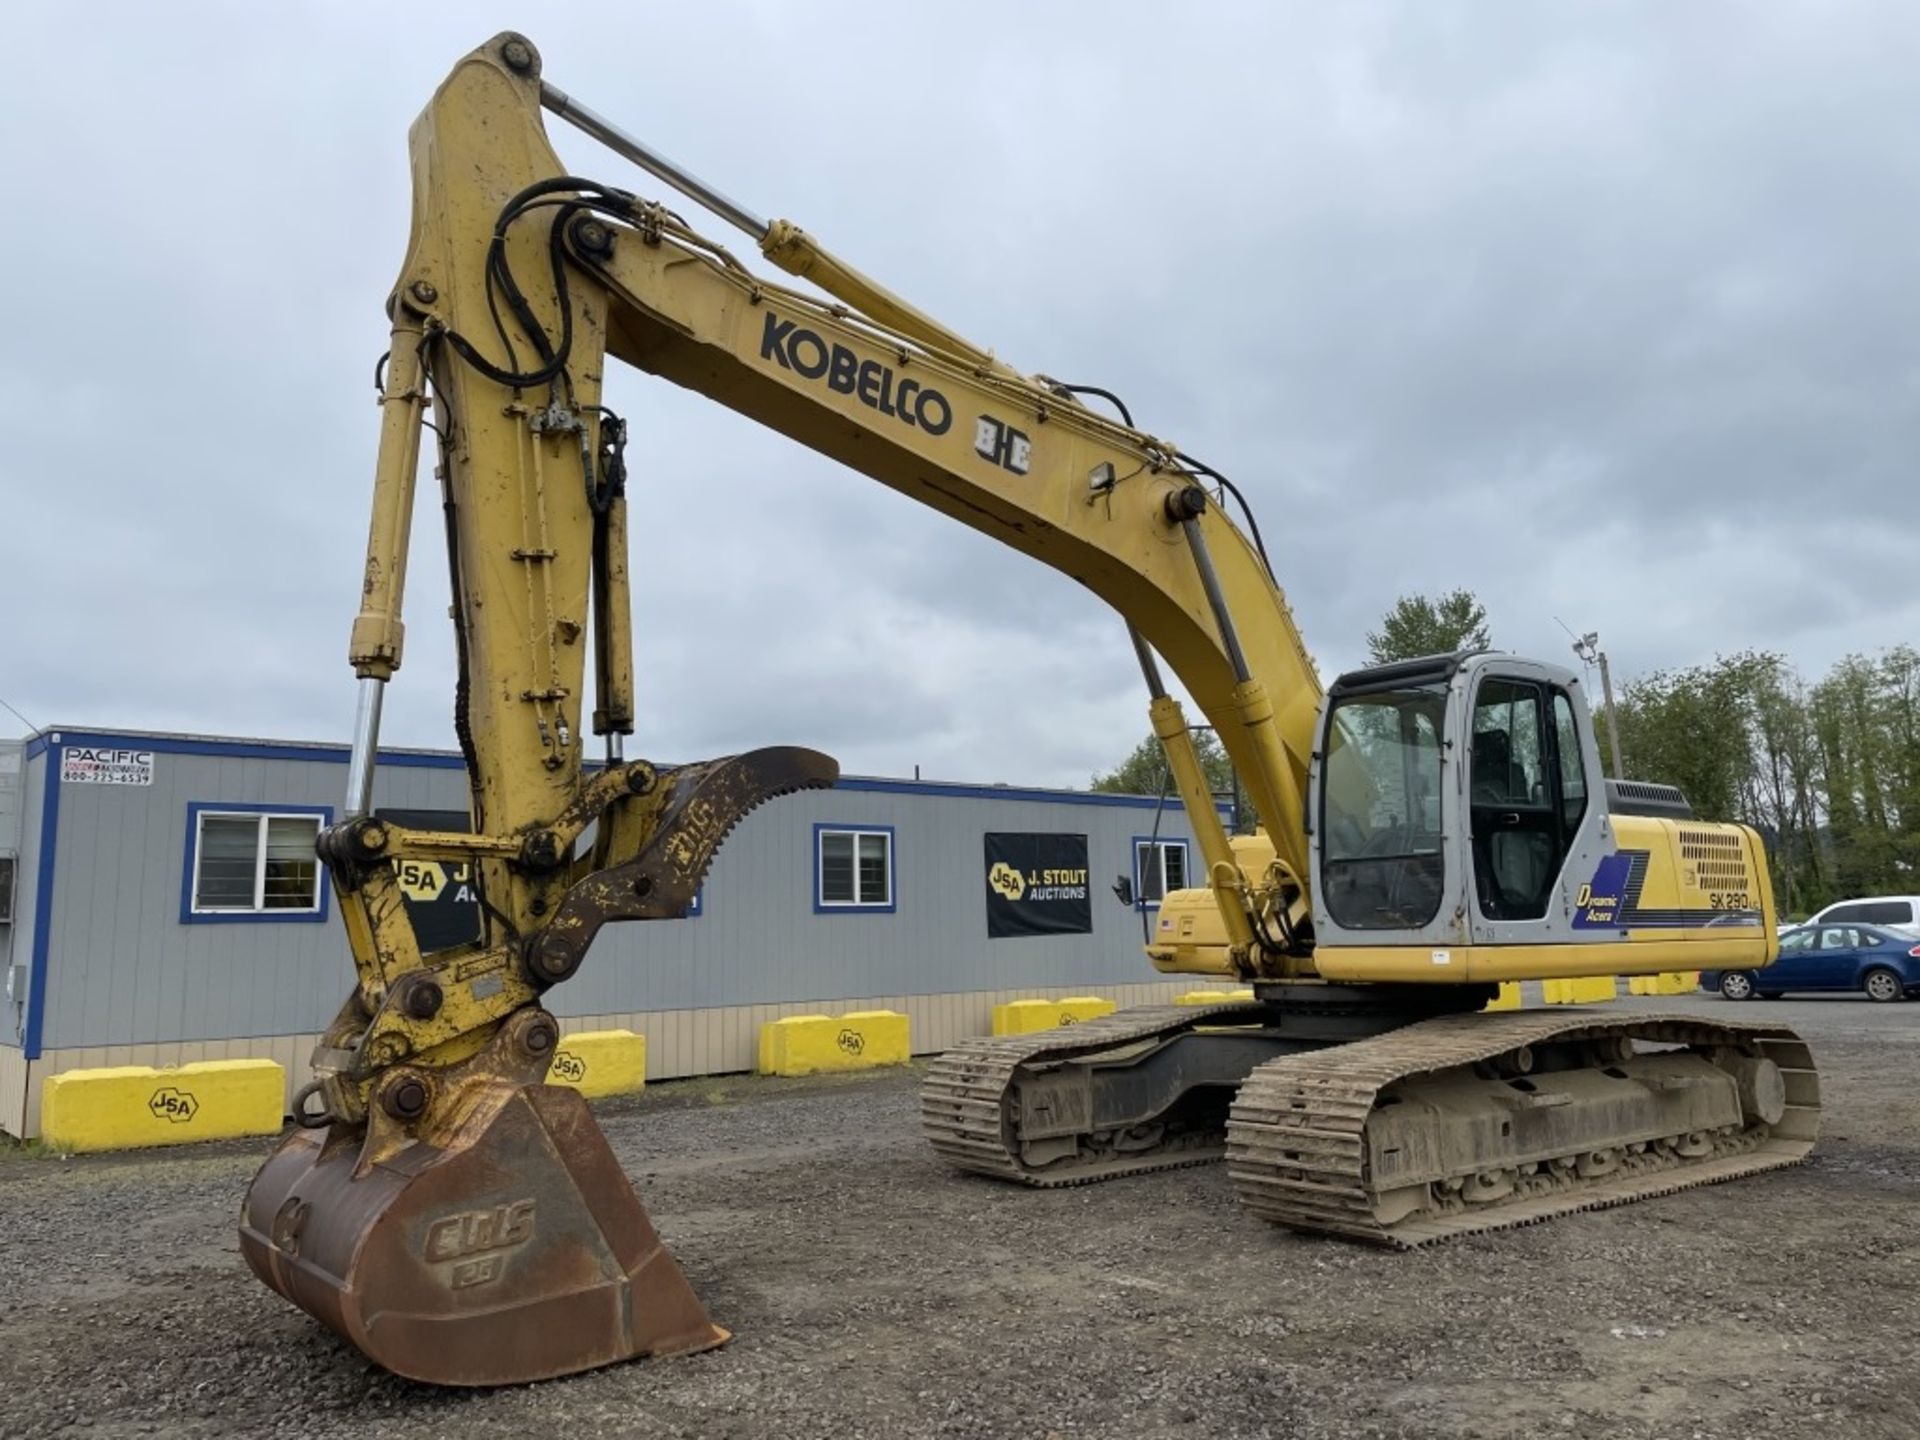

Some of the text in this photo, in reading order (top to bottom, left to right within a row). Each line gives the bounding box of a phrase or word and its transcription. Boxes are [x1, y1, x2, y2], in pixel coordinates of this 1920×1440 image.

[760, 311, 953, 436] KOBELCO
[992, 868, 1020, 893] JSA
[1028, 869, 1087, 886] J. STOUT
[1029, 886, 1086, 901] AUCTIONS
[1576, 884, 1618, 909] Dynamic
[839, 1034, 860, 1050] JSA
[554, 1056, 580, 1076] JSA
[153, 1092, 190, 1116] JSA
